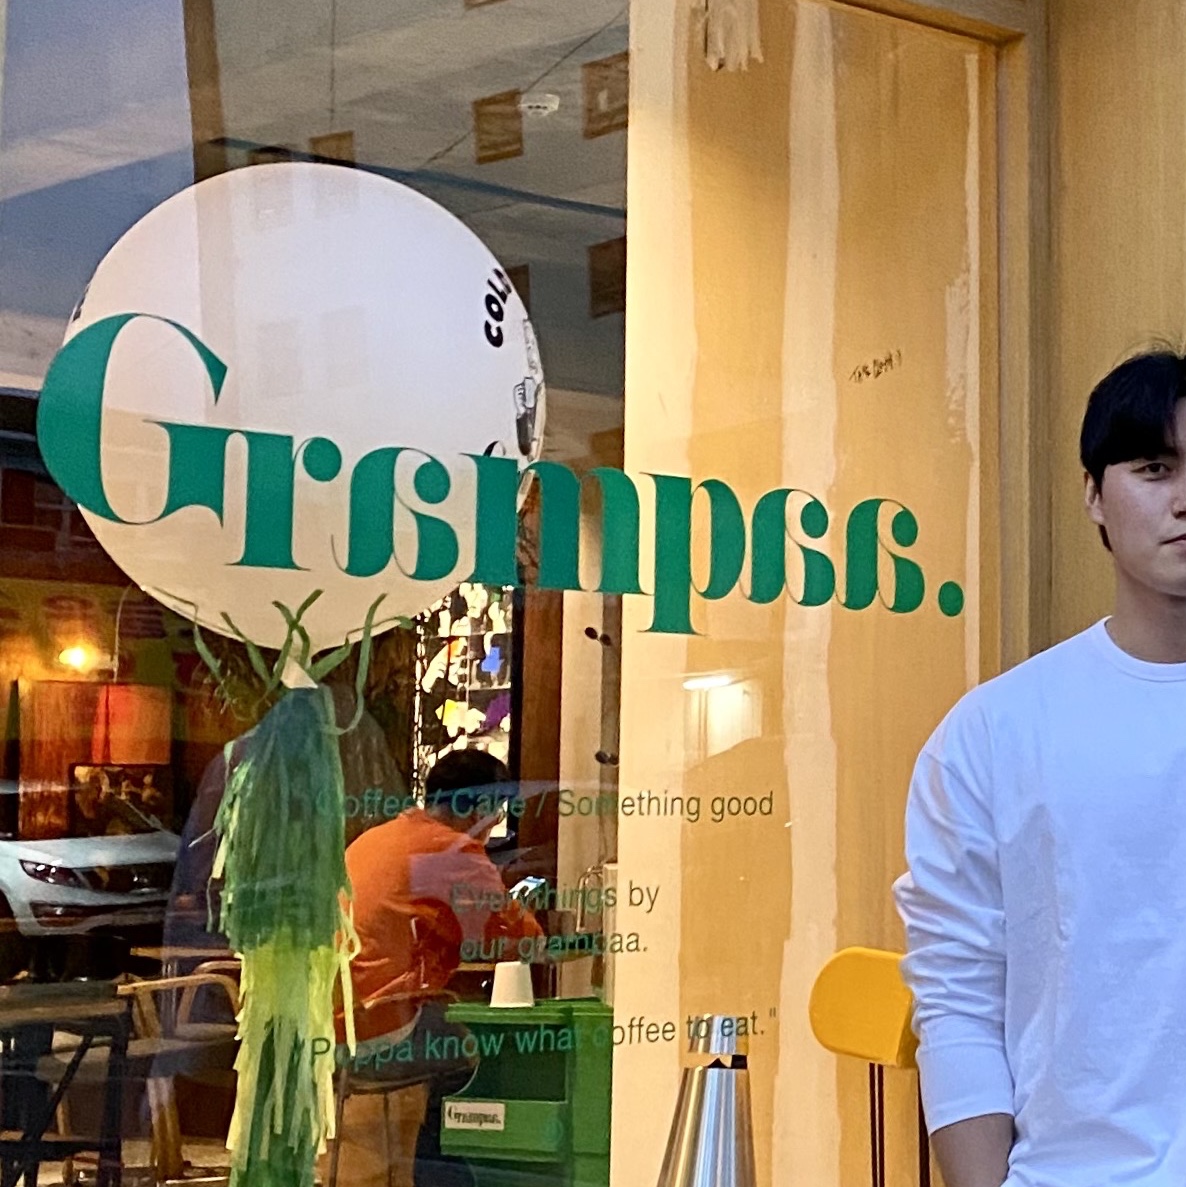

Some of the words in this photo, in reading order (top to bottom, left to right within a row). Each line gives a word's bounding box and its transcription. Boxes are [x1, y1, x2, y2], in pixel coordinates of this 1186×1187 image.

[37, 313, 964, 636] Grampaa.
[451, 787, 526, 819] Cake
[558, 788, 701, 823] Something
[711, 790, 774, 823] good
[628, 879, 660, 914] by
[459, 934, 505, 961] our
[425, 1029, 506, 1060] know
[514, 1023, 580, 1055] what
[592, 1015, 676, 1048] coffee
[686, 1014, 709, 1040] to
[720, 1006, 777, 1037] eat."
